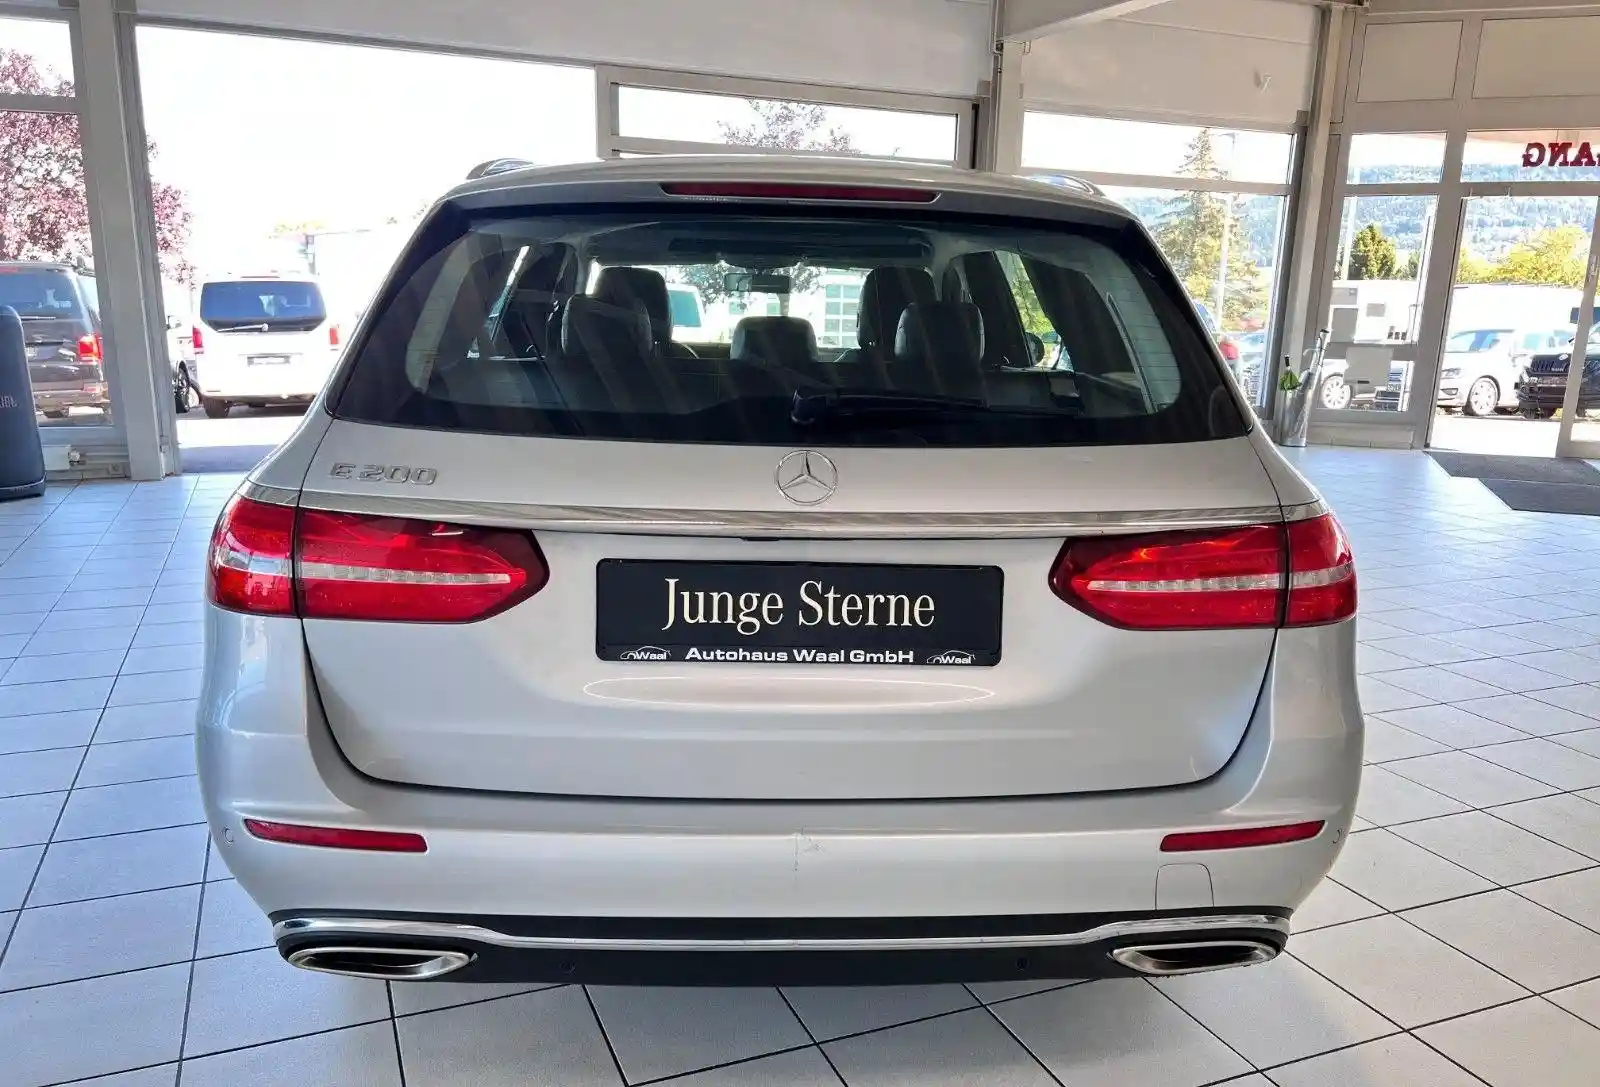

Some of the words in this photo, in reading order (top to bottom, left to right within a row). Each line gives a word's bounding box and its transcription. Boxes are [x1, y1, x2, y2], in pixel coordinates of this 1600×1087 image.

[330, 462, 356, 480] E
[357, 464, 438, 486] 200
[661, 578, 784, 636] Junge
[798, 580, 935, 627] Sterne
[635, 651, 668, 660] Waal
[684, 647, 789, 662] Autohaus
[792, 648, 845, 663] Waal
[849, 649, 914, 663] GmbH
[941, 655, 973, 664] Waal
